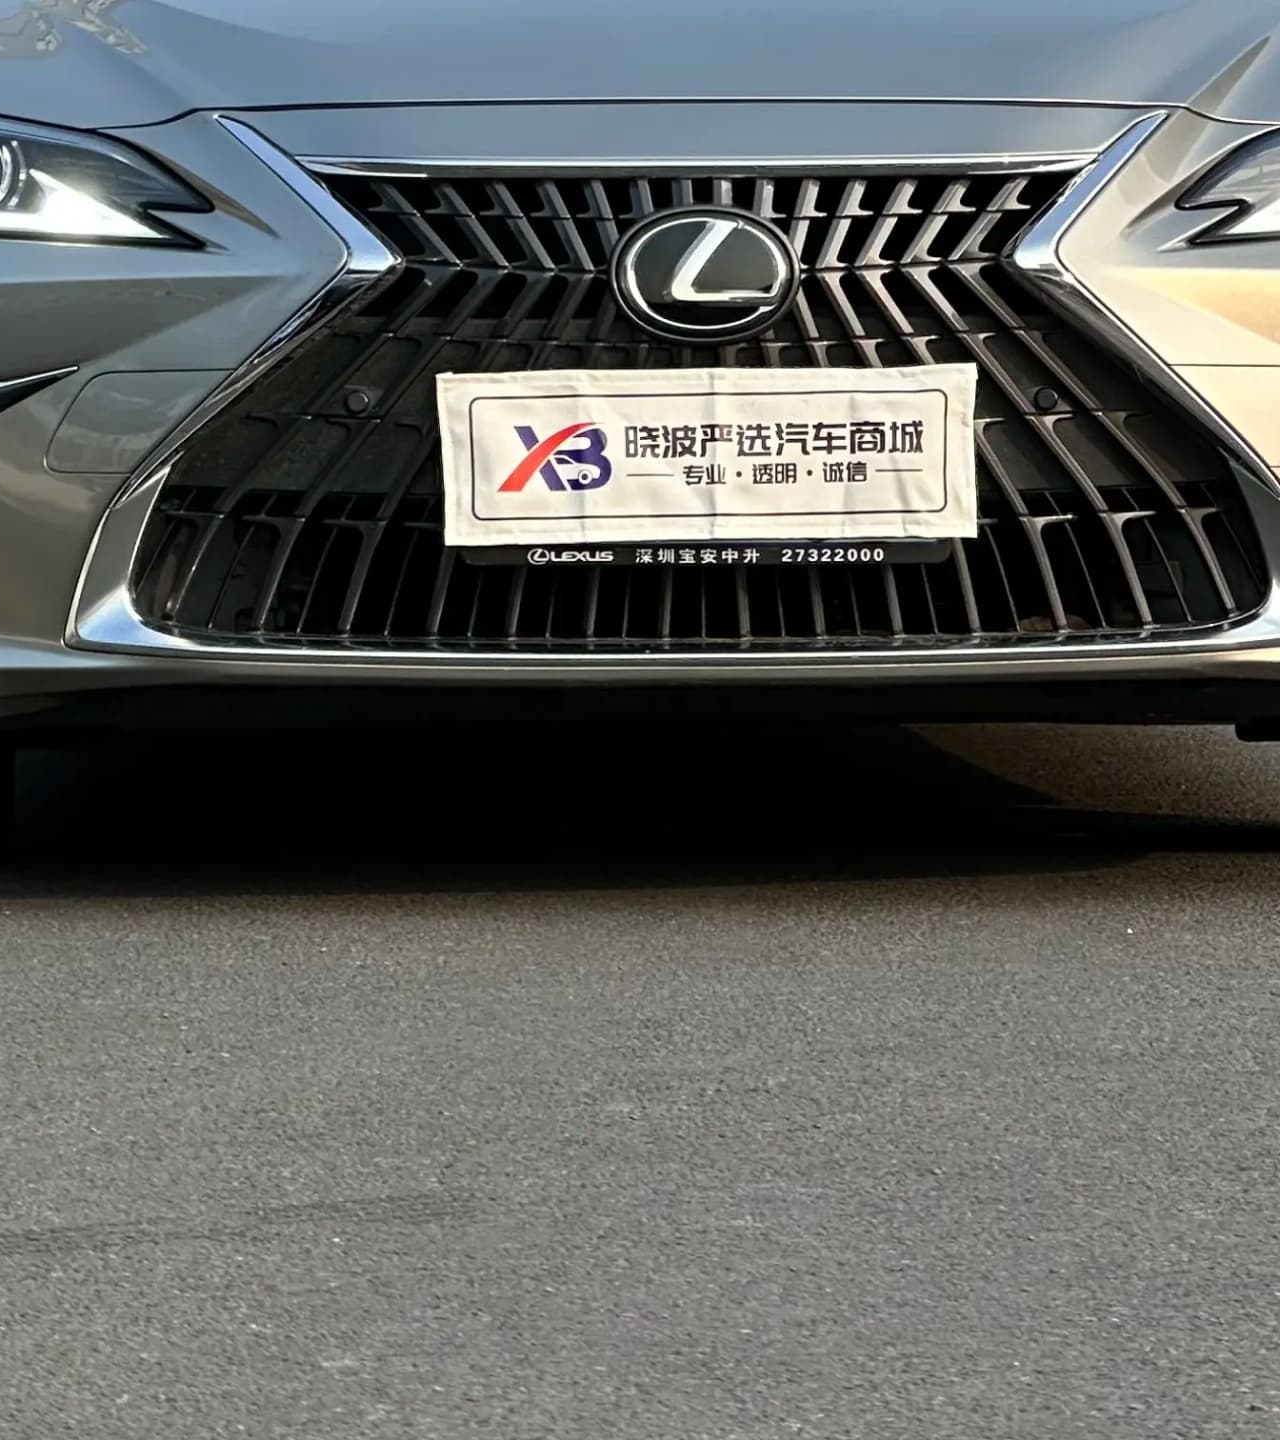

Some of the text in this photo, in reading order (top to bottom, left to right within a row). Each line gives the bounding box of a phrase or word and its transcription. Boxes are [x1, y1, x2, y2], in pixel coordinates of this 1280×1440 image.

[624, 420, 924, 459] 晓波严选汽车商城
[635, 548, 761, 564] 深圳宝安中升
[781, 548, 885, 562] 27322000
